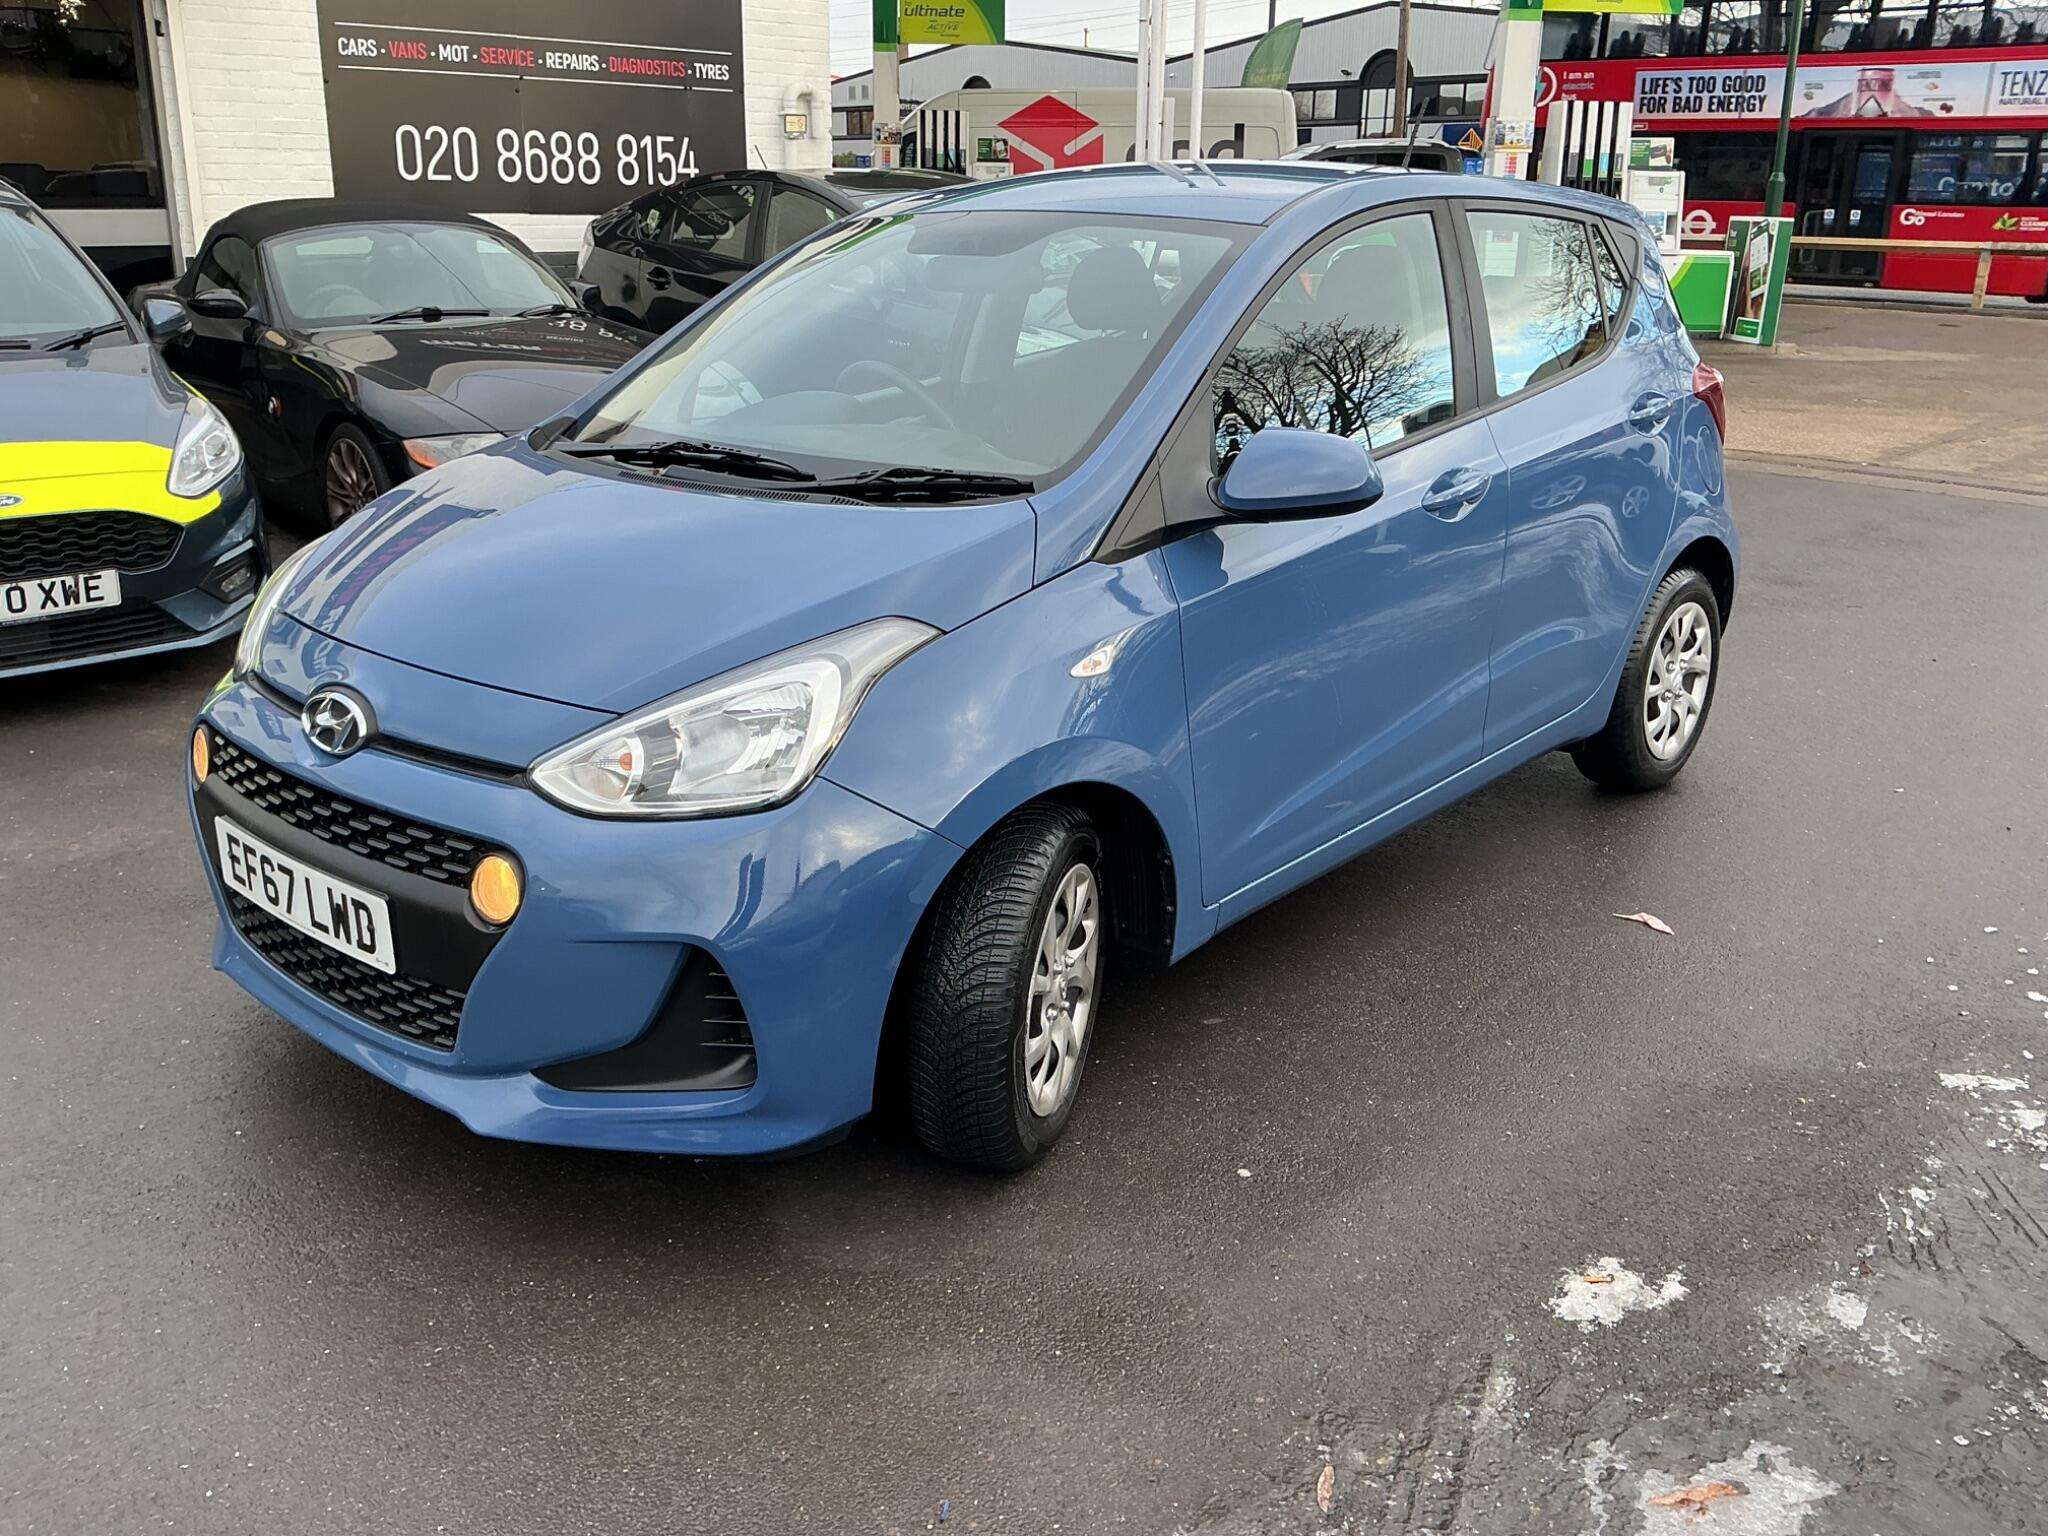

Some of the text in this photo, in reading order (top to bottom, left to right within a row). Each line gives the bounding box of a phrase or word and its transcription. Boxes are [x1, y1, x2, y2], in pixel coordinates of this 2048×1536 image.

[904, 5, 966, 17] ultimate
[337, 37, 730, 80] CARS VANS MOT SERVICE REPAIRS DIAGNOSTICS TYRES
[1640, 74, 1766, 94] LIFE'S TOO GOOD
[1639, 94, 1767, 114] FOR BAD ENERGY
[395, 124, 699, 186] 020 8688 8154
[1900, 208, 1925, 226] Go
[37, 575, 104, 610] XWE
[226, 832, 377, 956] EF67 LWD
